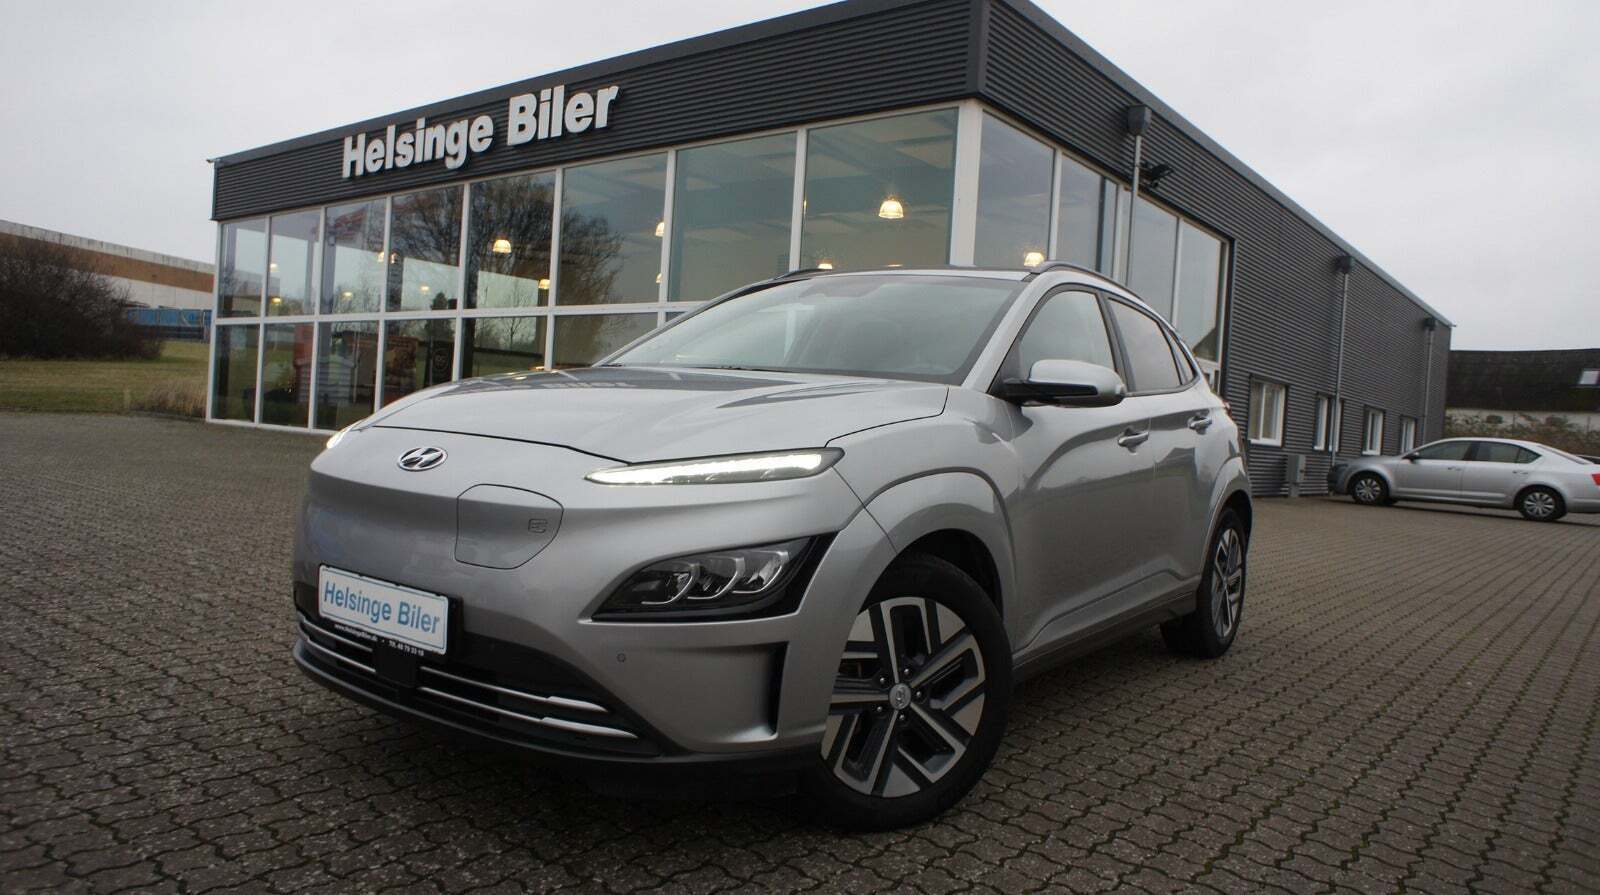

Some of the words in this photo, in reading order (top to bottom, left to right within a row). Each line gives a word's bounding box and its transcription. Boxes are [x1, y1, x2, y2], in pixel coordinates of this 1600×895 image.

[342, 115, 494, 178] Helsinge
[507, 85, 620, 146] Biler
[324, 581, 392, 623] Helsinge
[397, 601, 440, 634] Biler
